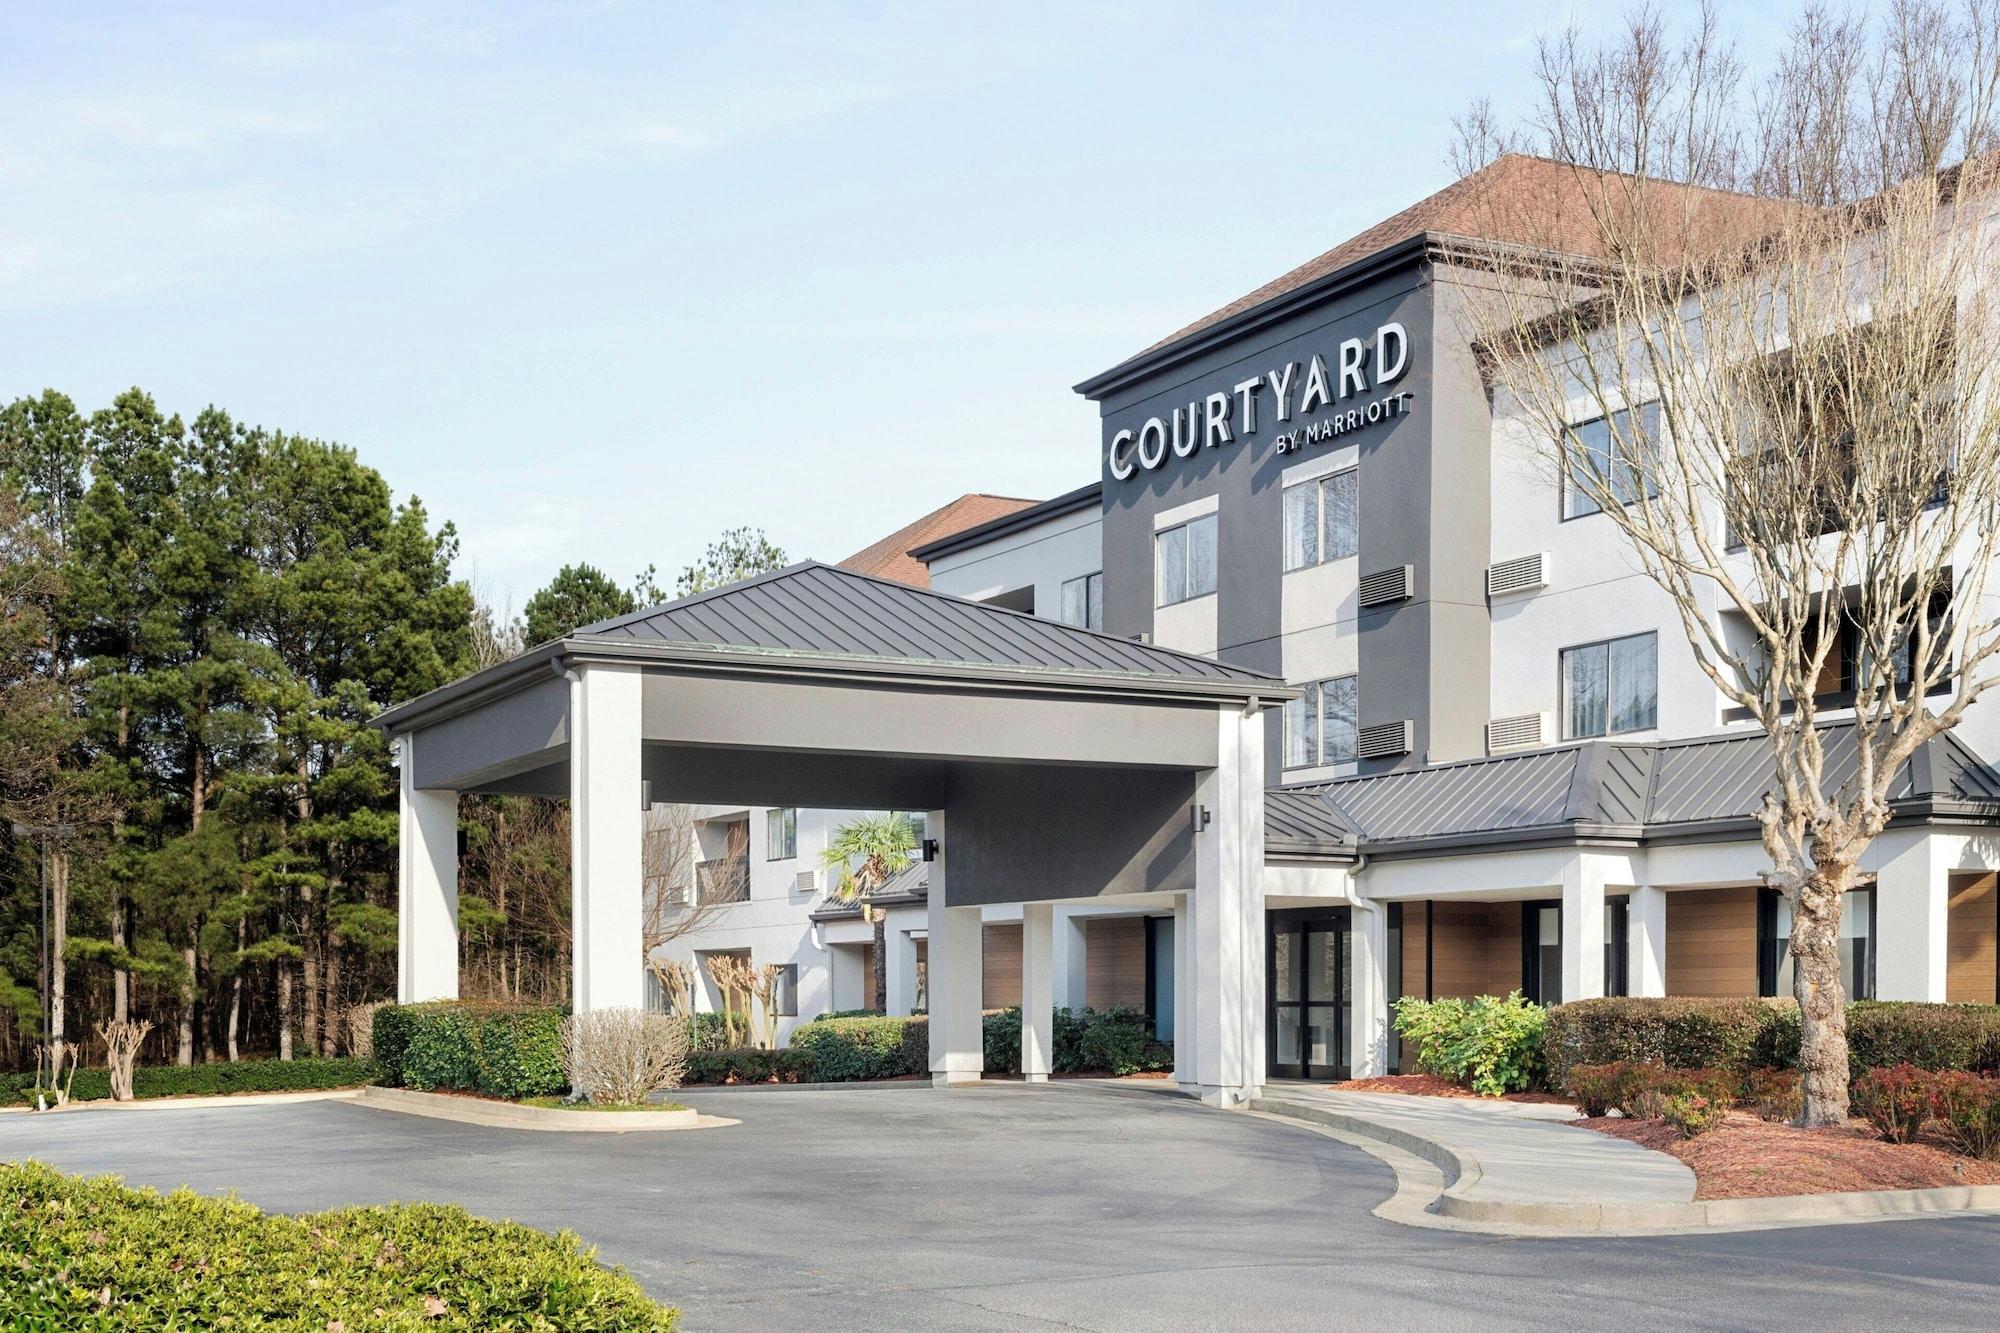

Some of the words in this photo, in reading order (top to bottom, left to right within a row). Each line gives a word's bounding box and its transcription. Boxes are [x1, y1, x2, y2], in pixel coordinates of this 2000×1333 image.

[1109, 322, 1410, 481] COURTYARD
[1276, 428, 1298, 455] BY
[1306, 391, 1412, 444] MARRIOTT
